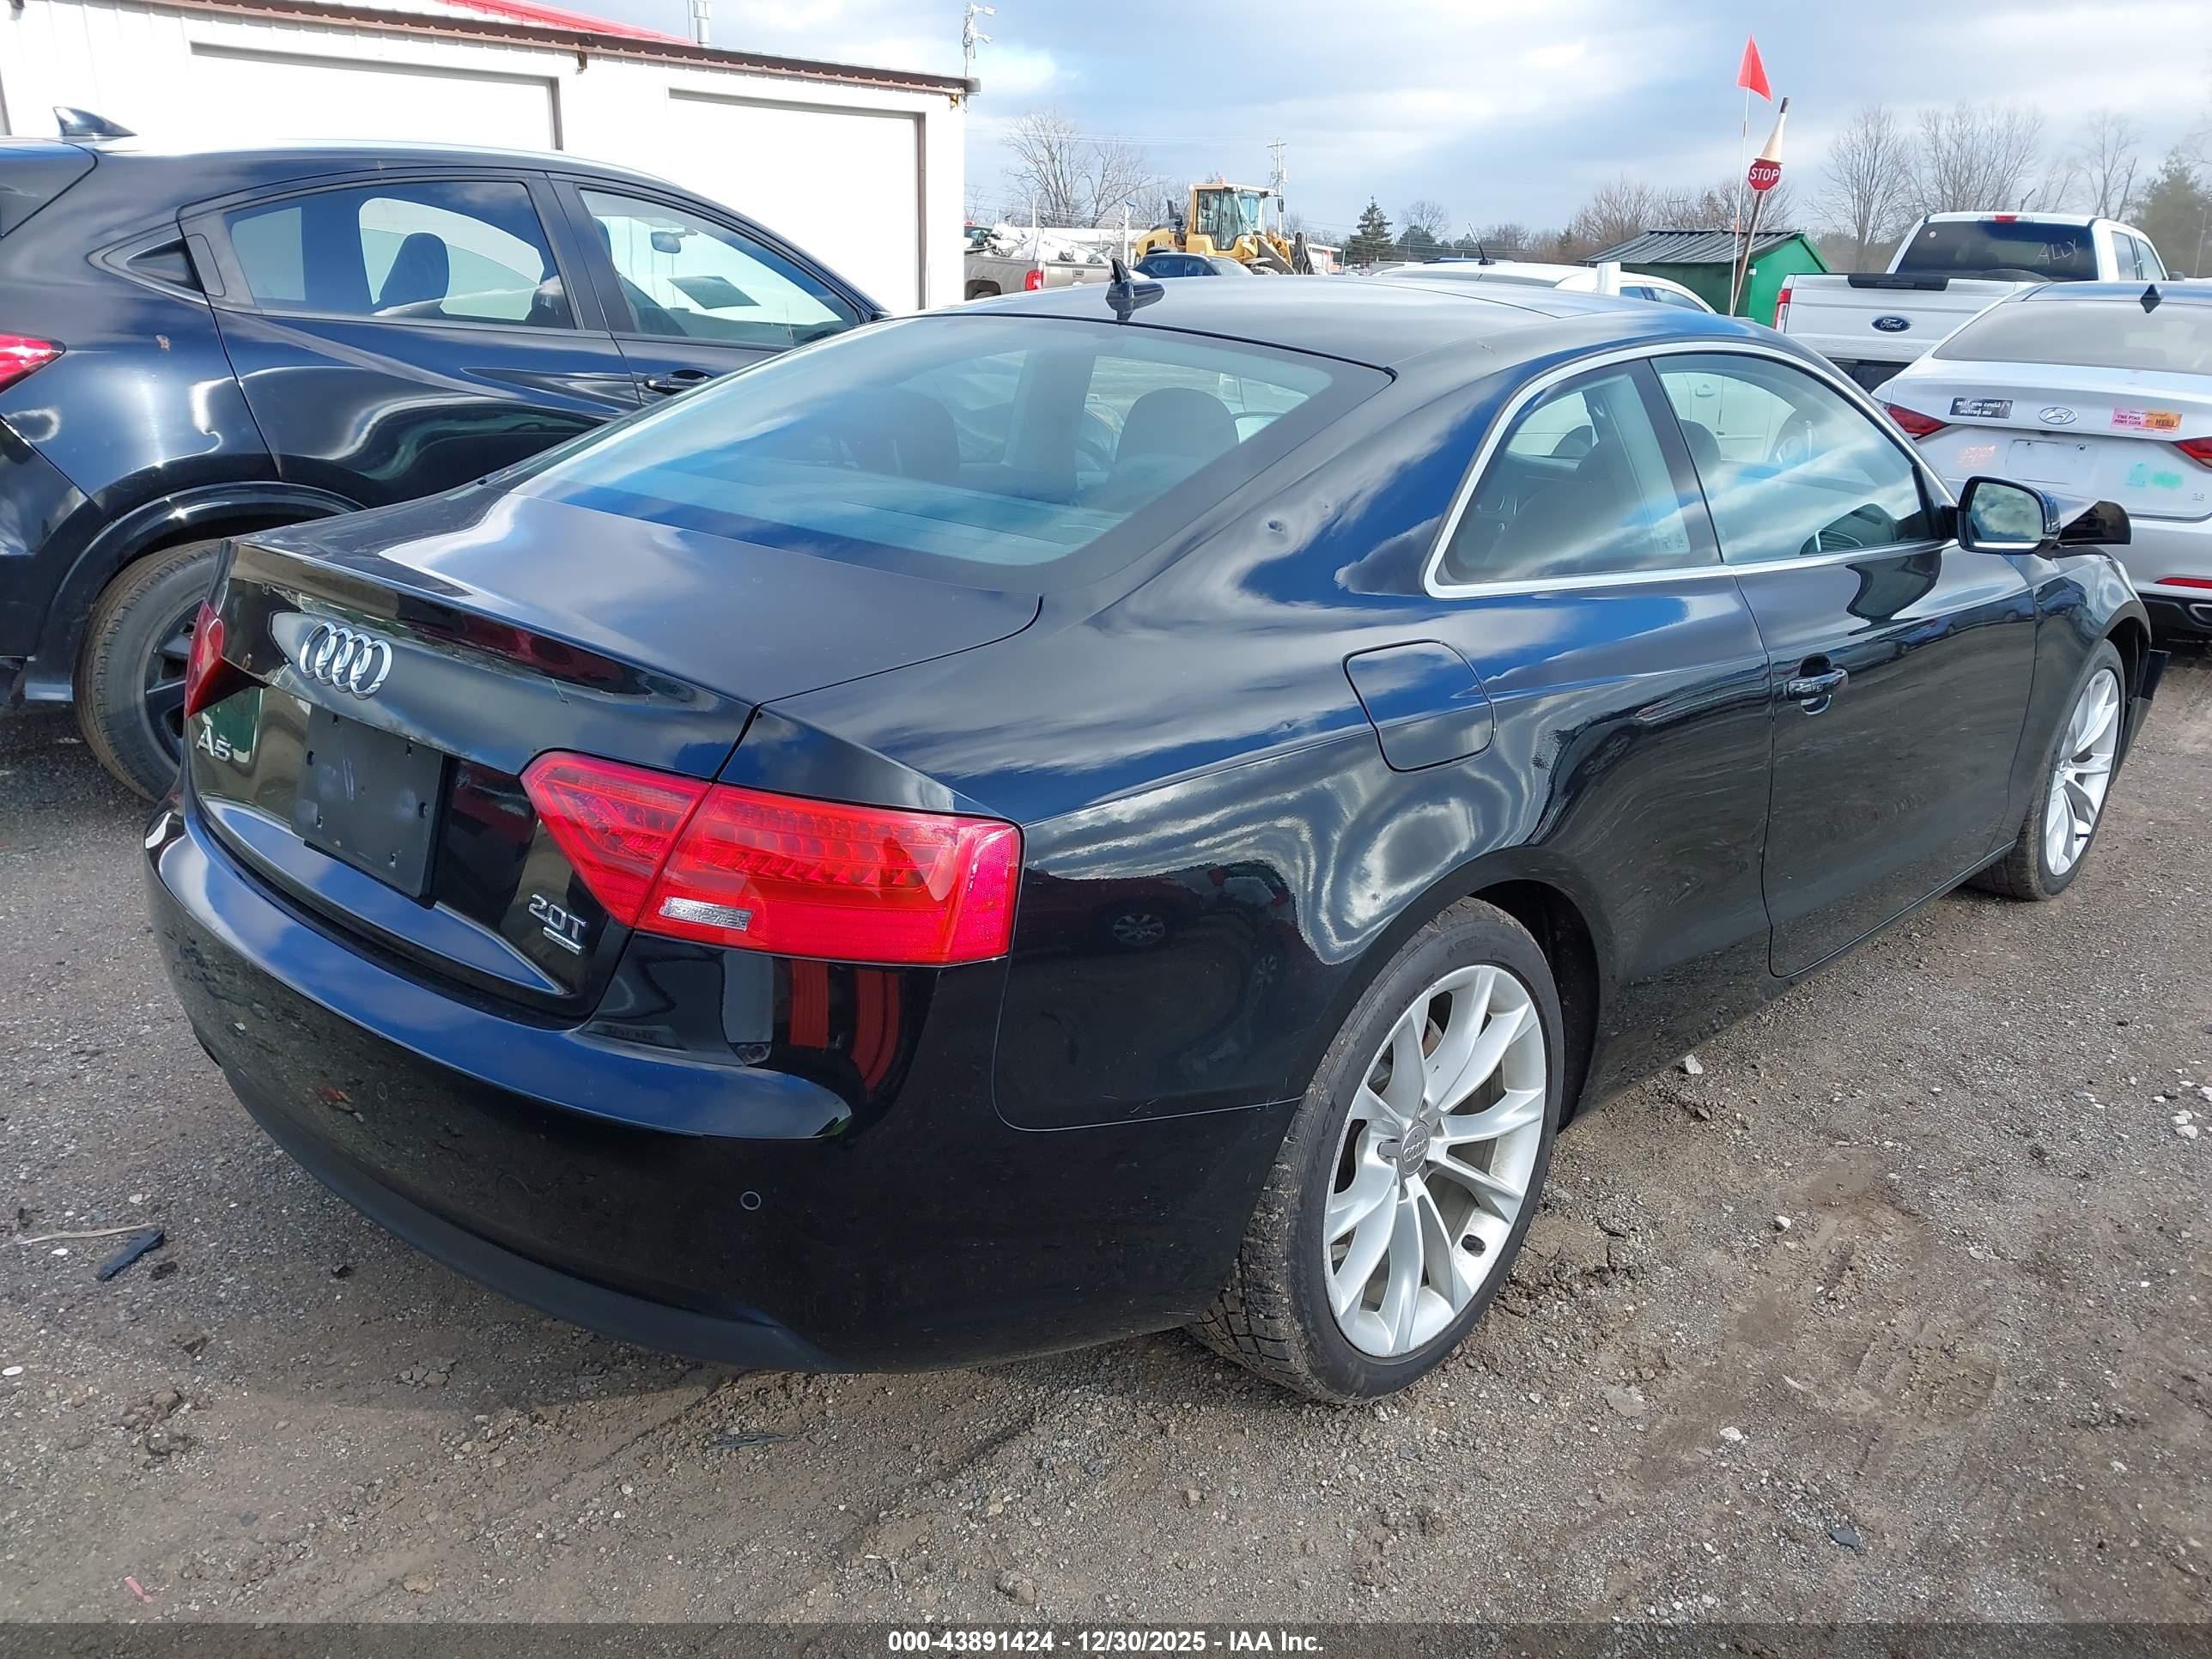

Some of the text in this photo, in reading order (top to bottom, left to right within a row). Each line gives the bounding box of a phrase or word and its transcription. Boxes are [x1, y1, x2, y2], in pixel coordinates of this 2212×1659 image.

[1749, 167, 1779, 181] STOP
[2034, 239, 2077, 264] ALLY
[1880, 318, 1903, 330] Ford
[2155, 418, 2177, 428] HELL
[196, 725, 233, 762] A5
